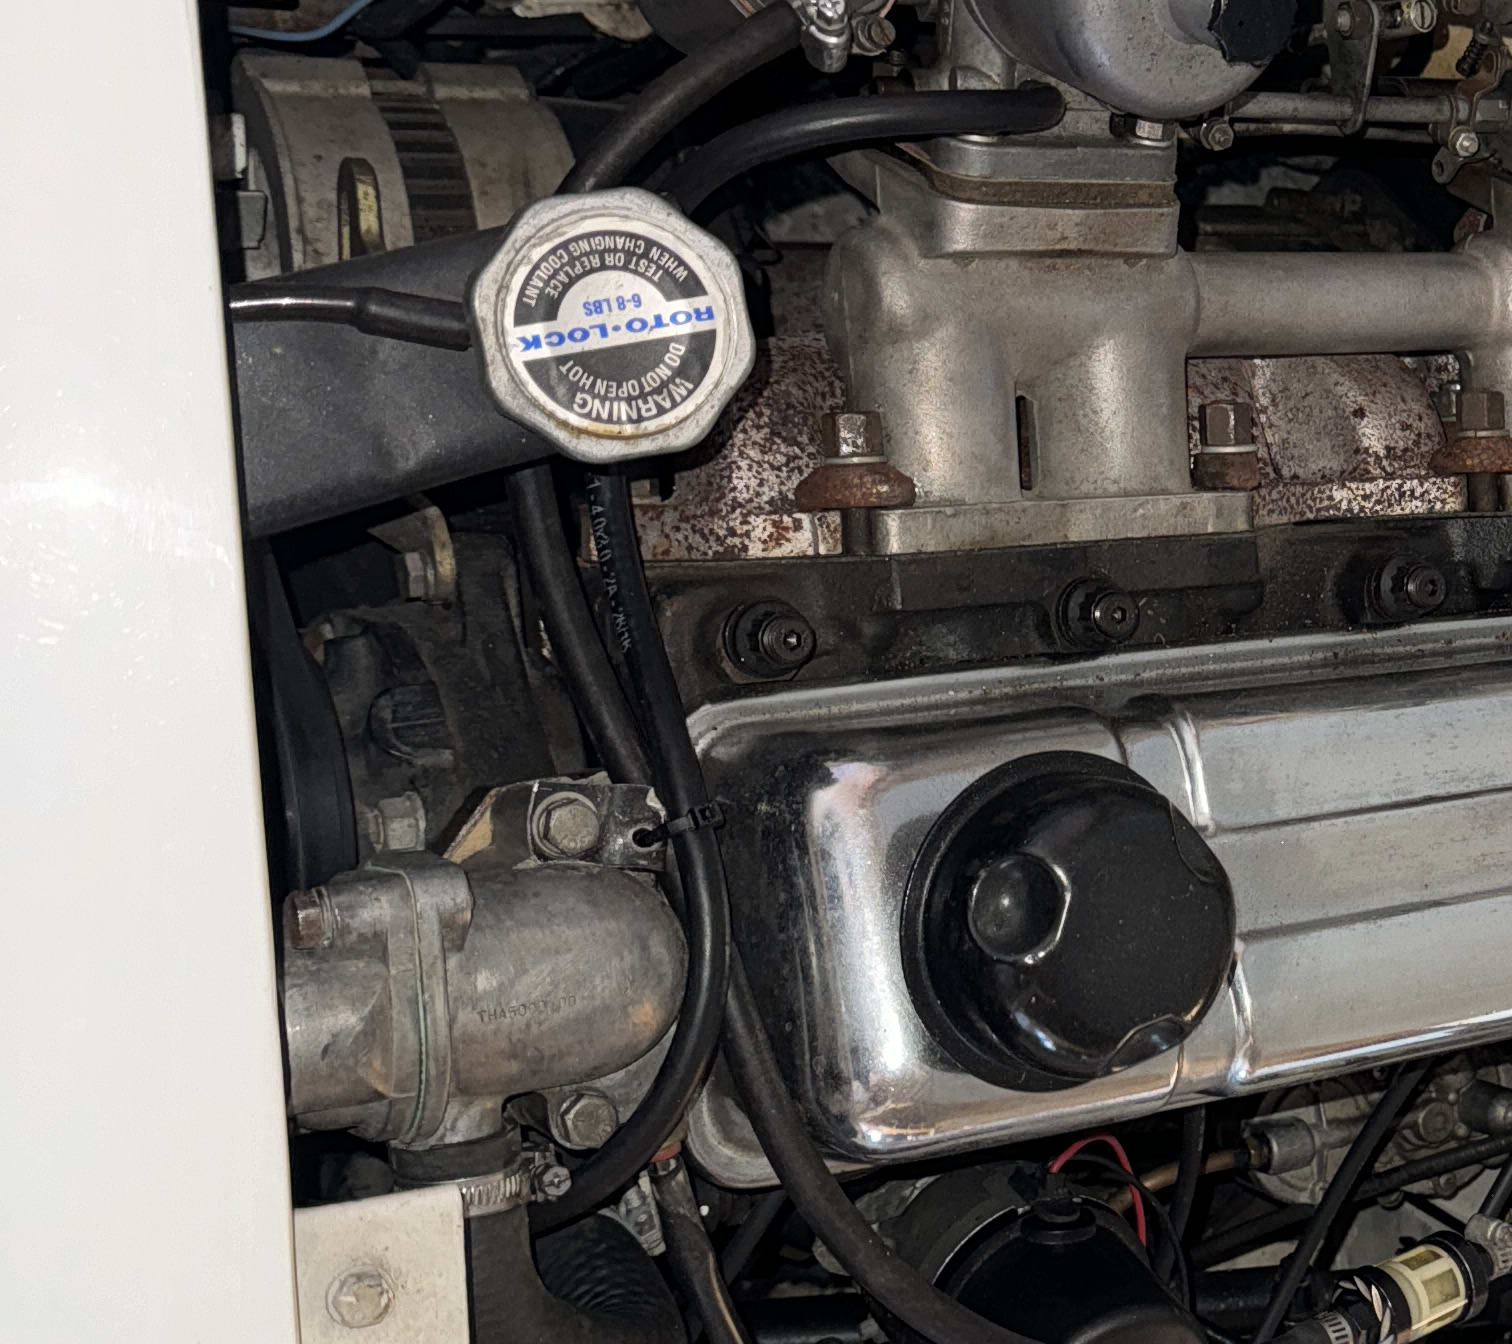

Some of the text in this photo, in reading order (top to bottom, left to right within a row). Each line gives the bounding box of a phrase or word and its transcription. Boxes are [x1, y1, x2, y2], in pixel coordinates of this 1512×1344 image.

[522, 235, 689, 308] WHEN CHANGING COOLANT
[545, 252, 665, 301] TEST OR REPLACE
[582, 293, 643, 317] 6-8 LBS
[558, 342, 686, 398] DO NOT OPEN HOT
[572, 377, 695, 422] WARNING
